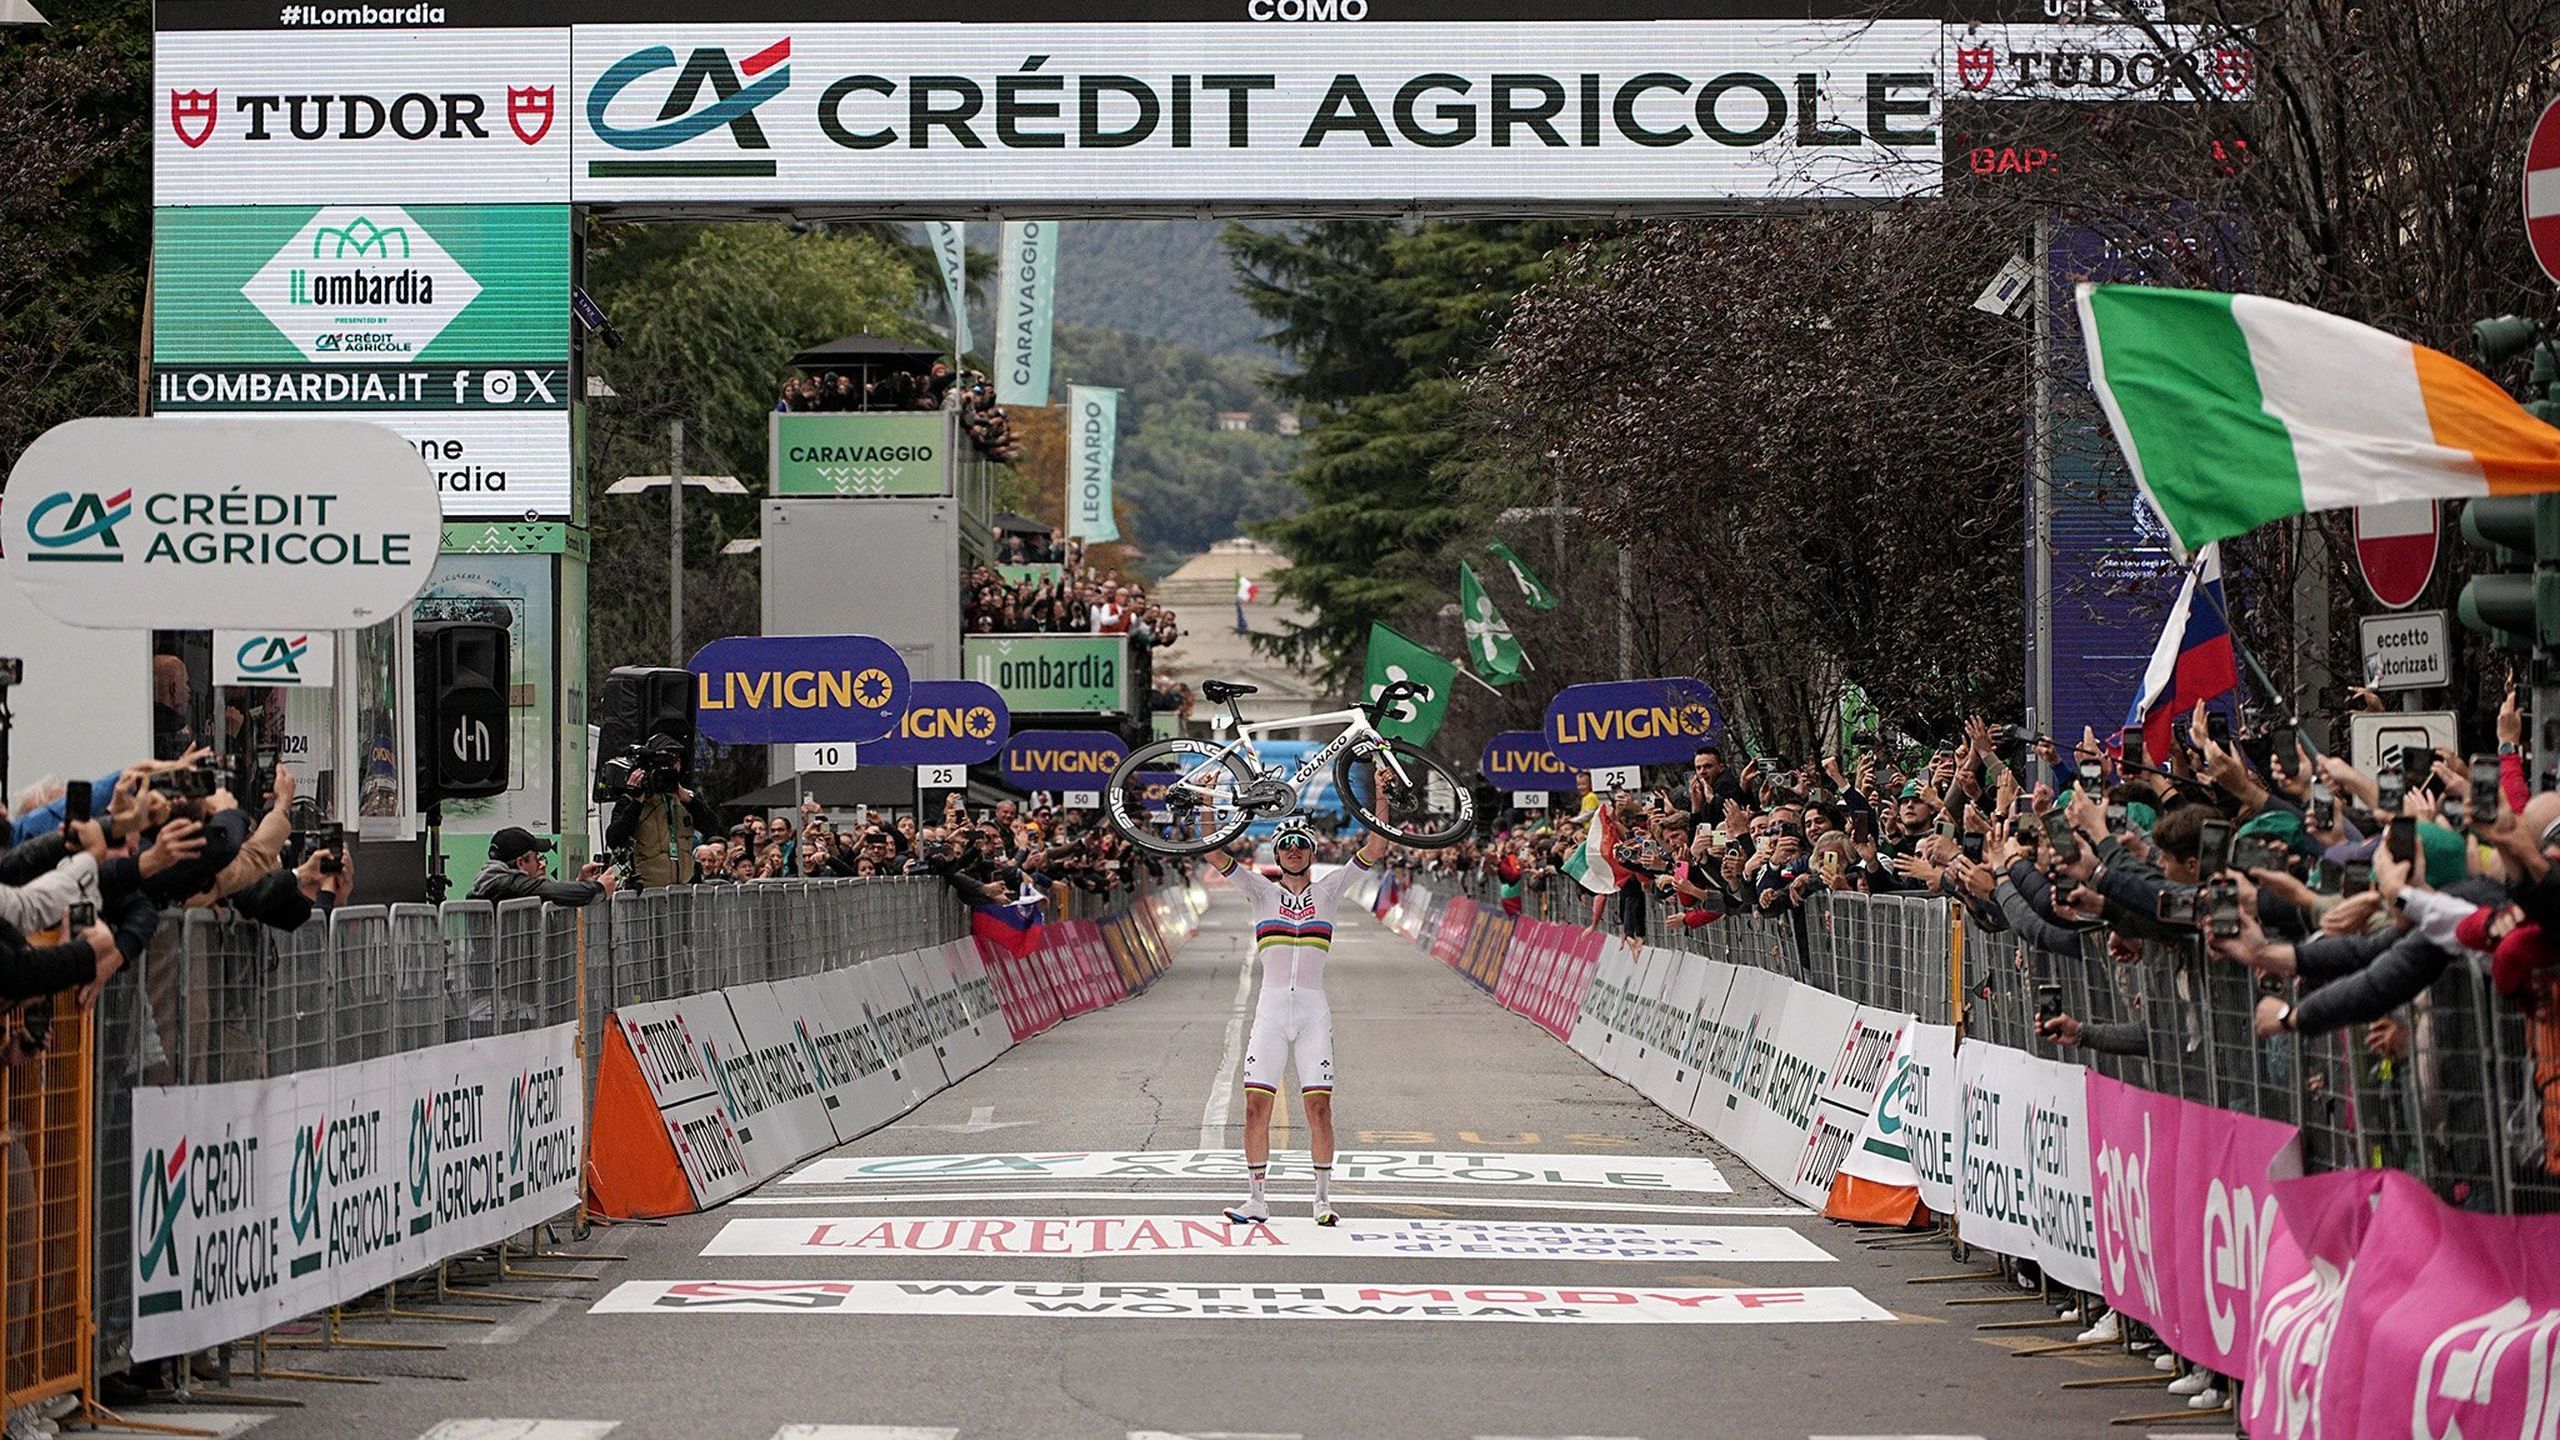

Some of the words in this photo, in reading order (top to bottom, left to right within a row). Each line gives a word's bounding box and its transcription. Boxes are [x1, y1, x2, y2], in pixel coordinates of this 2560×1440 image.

[280, 3, 445, 25] #ILombardia
[1247, 0, 1368, 21] COMO
[2009, 51, 2210, 90] TUDOR
[236, 92, 489, 141] TUDOR
[818, 55, 1275, 149] CRÉDIT
[1299, 72, 1936, 149] AGRICOLE
[1970, 147, 2059, 174] GAP:
[290, 267, 433, 305] ILombardia
[1014, 222, 1039, 385] CARAVAGGIO
[345, 332, 393, 343] CRÉDIT
[345, 343, 411, 352] AGRICOLE
[160, 373, 428, 402] ILOMBARDIA.IT
[410, 440, 463, 461] ne
[789, 446, 933, 463] CARAVAGGIO
[1084, 401, 1102, 522] LEONARDO
[145, 485, 337, 525] CRÉDIT
[143, 533, 411, 565] AGRICOLE
[2377, 628, 2429, 649] eccetto
[2383, 653, 2438, 676] torizzati
[699, 668, 893, 709] LIVIGNO
[1556, 703, 1711, 744] LIVIGNO
[283, 735, 308, 753] 024
[814, 747, 839, 766] 10
[1296, 735, 1347, 784] COLNAGO
[933, 769, 952, 784] 25
[1010, 749, 1121, 774] LIVIGNO
[1491, 749, 1578, 774] LIVIG
[1606, 771, 1626, 787] 25
[1074, 794, 1089, 804] 50
[1525, 793, 1539, 805] 50
[1281, 894, 1314, 911] UAE
[641, 1020, 700, 1085] TUDOR
[1843, 1027, 1893, 1093] TUDOR
[527, 1056, 564, 1128] CRÉDIT
[434, 1073, 484, 1153] CRÉDIT
[327, 1100, 380, 1187] CRÉDIT
[682, 1115, 740, 1183] TUDOR
[190, 1124, 258, 1218] CRÉDIT
[527, 1126, 577, 1195] AGRICOLE
[435, 1151, 504, 1227] AGRICOLE
[1963, 1154, 2028, 1226] GRICOLE
[327, 1182, 401, 1266] AGRICOLE
[801, 1219, 1290, 1253] LAURETANA
[1473, 1232, 1724, 1248] leggera
[193, 1217, 279, 1308] AGRICOLE
[1024, 1302, 1592, 1319] WORKWEAR
[1357, 1288, 1807, 1308] MODYF
